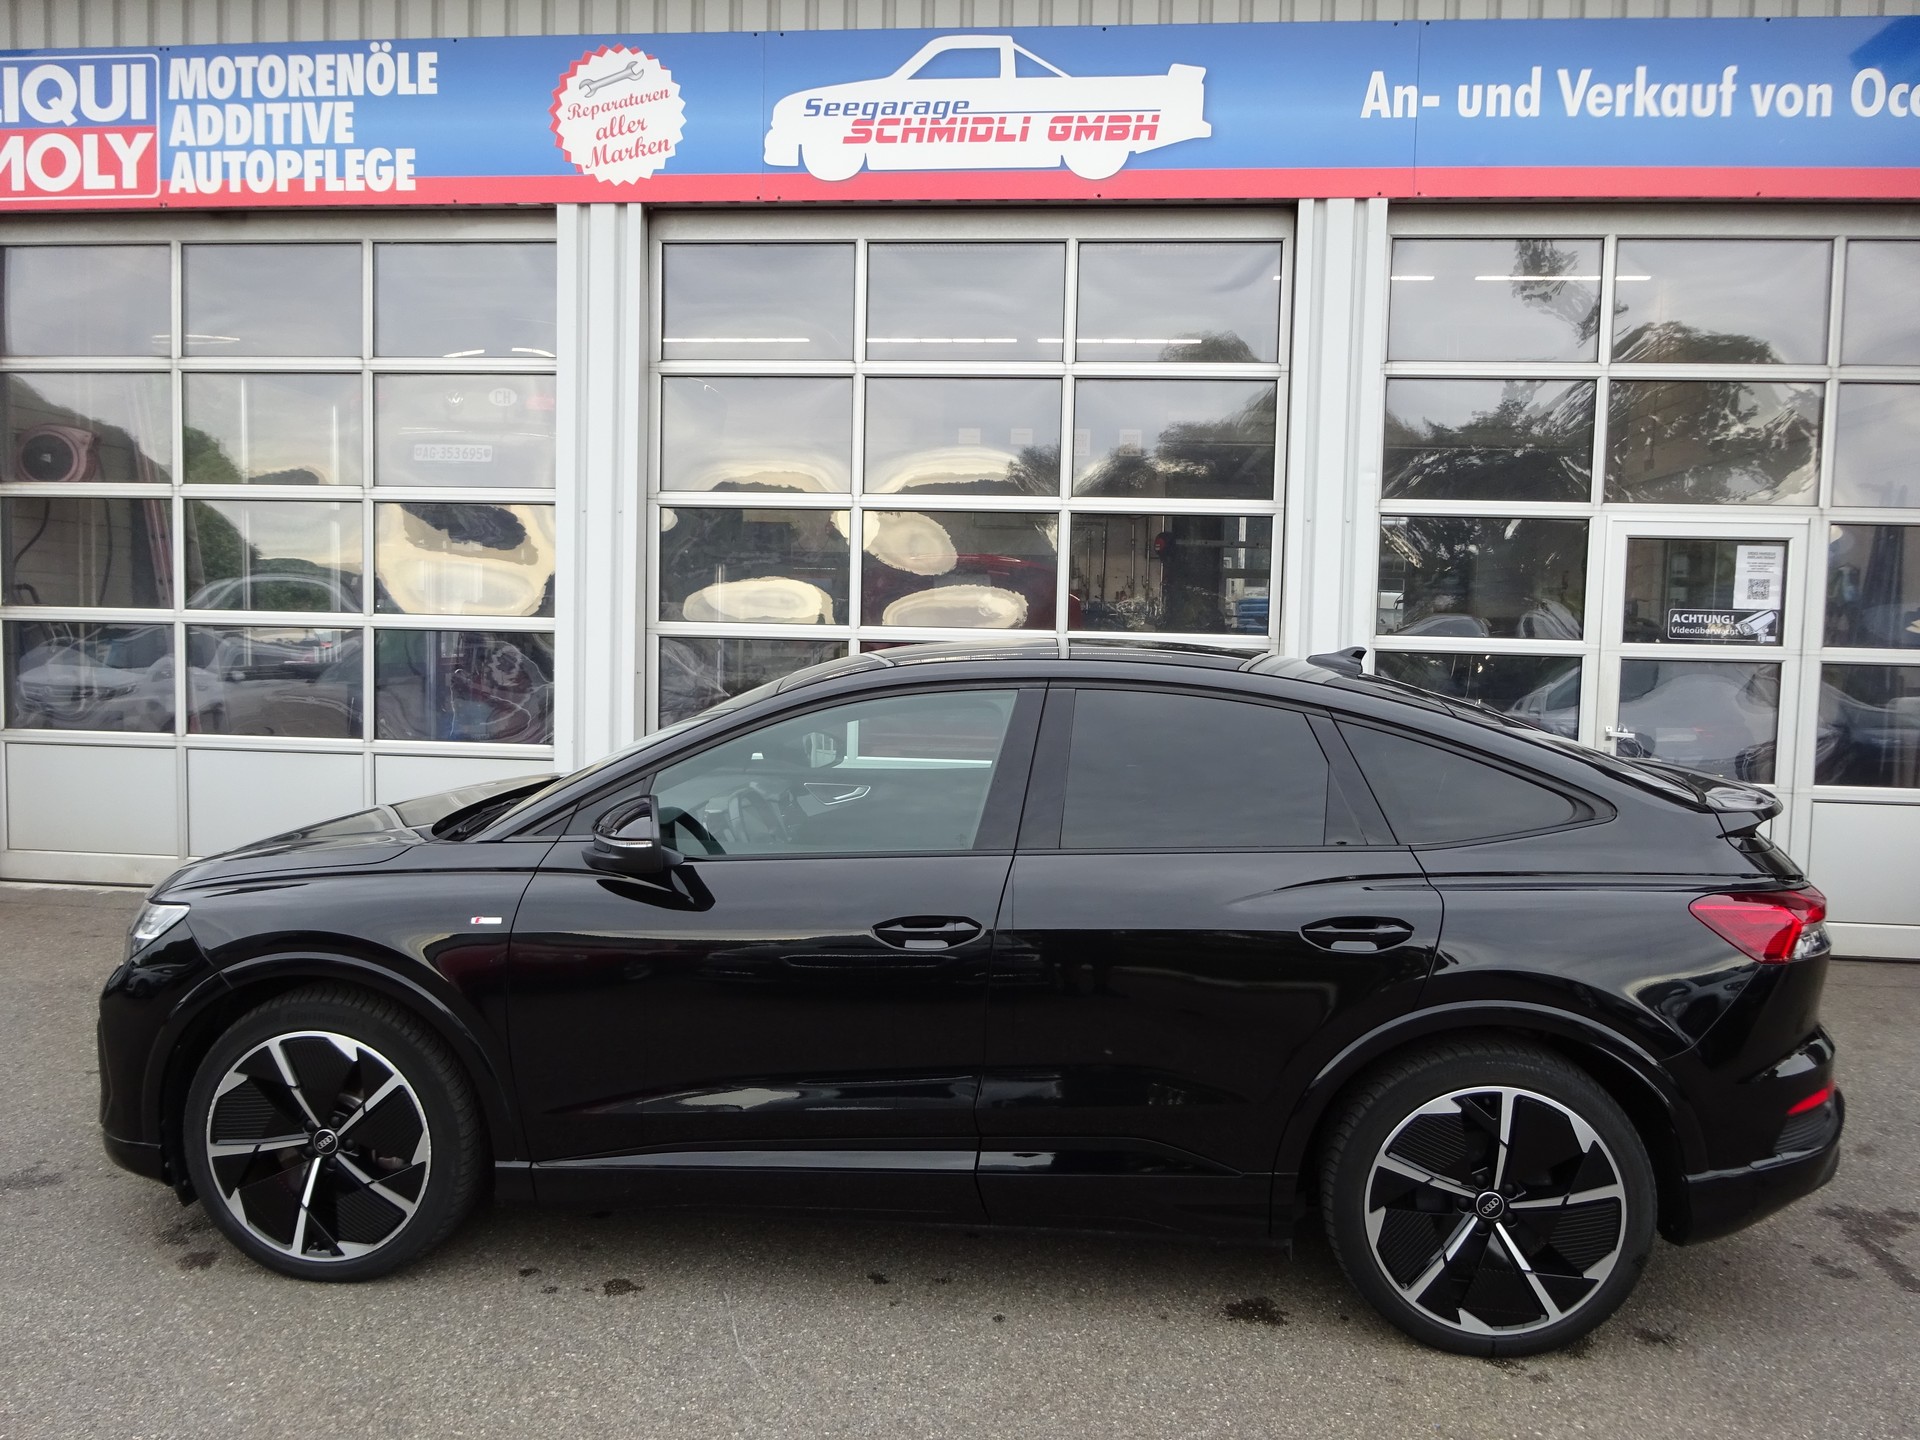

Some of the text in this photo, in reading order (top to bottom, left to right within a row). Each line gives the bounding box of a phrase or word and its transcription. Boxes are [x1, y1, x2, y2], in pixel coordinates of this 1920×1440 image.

[168, 41, 438, 100] MOTORENÖLE
[0, 63, 147, 126] IQUI
[567, 88, 670, 120] Reparaturen
[1360, 71, 1440, 118] An-
[1458, 66, 1542, 117] und
[1557, 65, 1738, 118] Verkauf
[1750, 83, 1832, 117] von
[168, 101, 354, 147] ADDITIVE
[804, 98, 970, 120] Seegarage
[595, 114, 648, 141] aller
[1047, 115, 1160, 141] GMBH
[585, 136, 671, 169] Marken
[168, 147, 416, 195] AUTOPFLEGE
[1671, 613, 1735, 624] ACHTUNG!
[1671, 626, 1739, 636] Videoüberwacht
